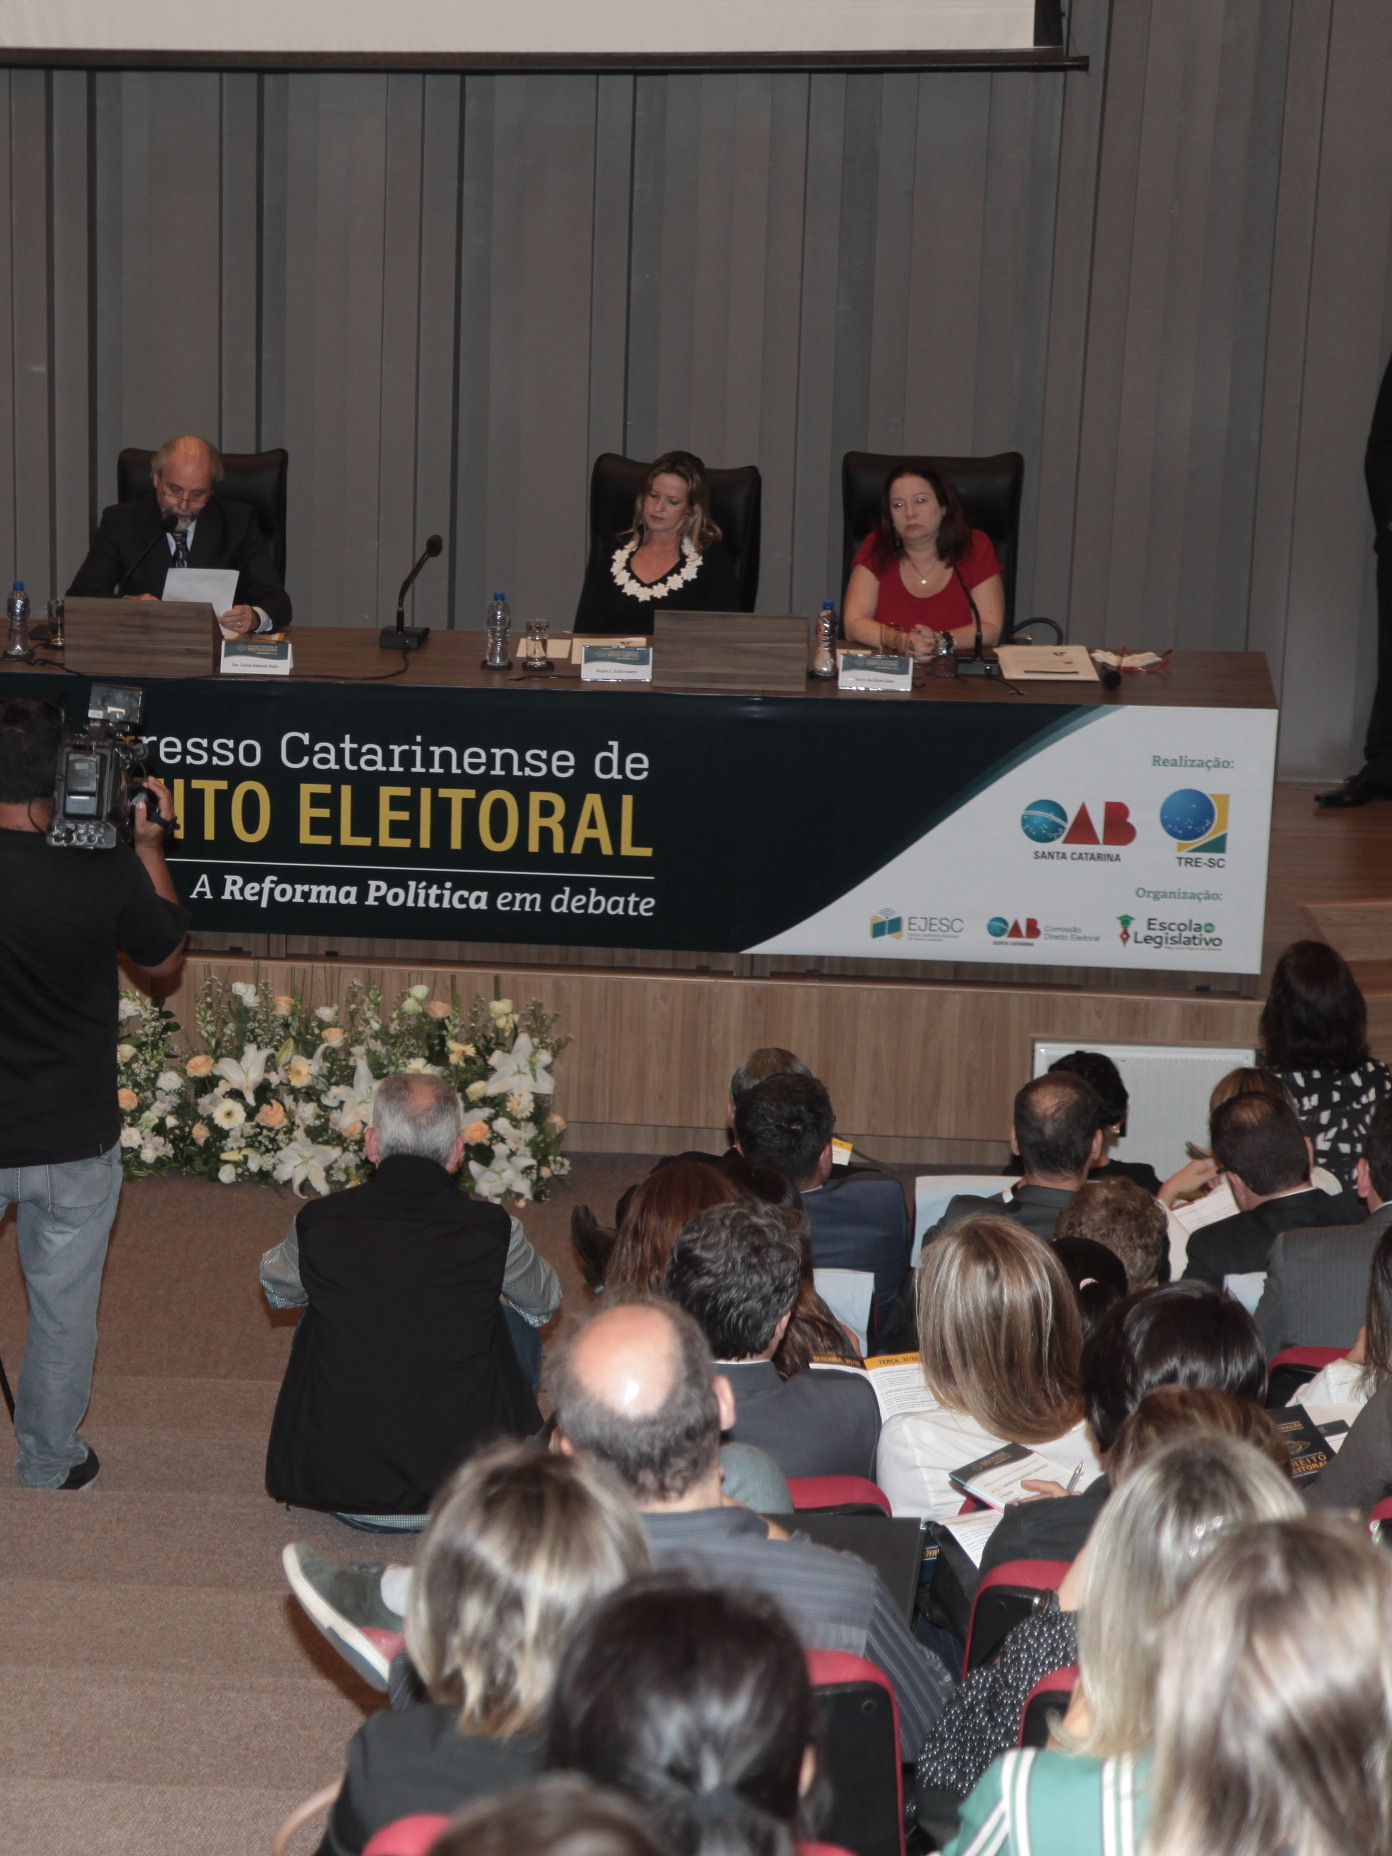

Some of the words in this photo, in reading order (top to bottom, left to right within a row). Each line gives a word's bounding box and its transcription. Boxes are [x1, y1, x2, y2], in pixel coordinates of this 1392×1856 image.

[281, 731, 575, 779] Catarinense
[594, 741, 650, 780] de
[1152, 755, 1235, 771] Realização:
[158, 778, 272, 843] ITO
[299, 783, 654, 857] ELEITORAL
[1033, 851, 1068, 861] SANTA
[1070, 852, 1121, 862] CATARINA
[1176, 857, 1226, 869] TRE-SC
[190, 874, 213, 899] A
[220, 875, 358, 908] Reforma
[365, 881, 488, 910] Política
[496, 892, 542, 912] em
[550, 887, 656, 917] debate
[1135, 887, 1224, 903] Organização:
[908, 916, 964, 933] EJESC
[1147, 918, 1203, 933] Escola
[1134, 931, 1223, 949] Legislativo
